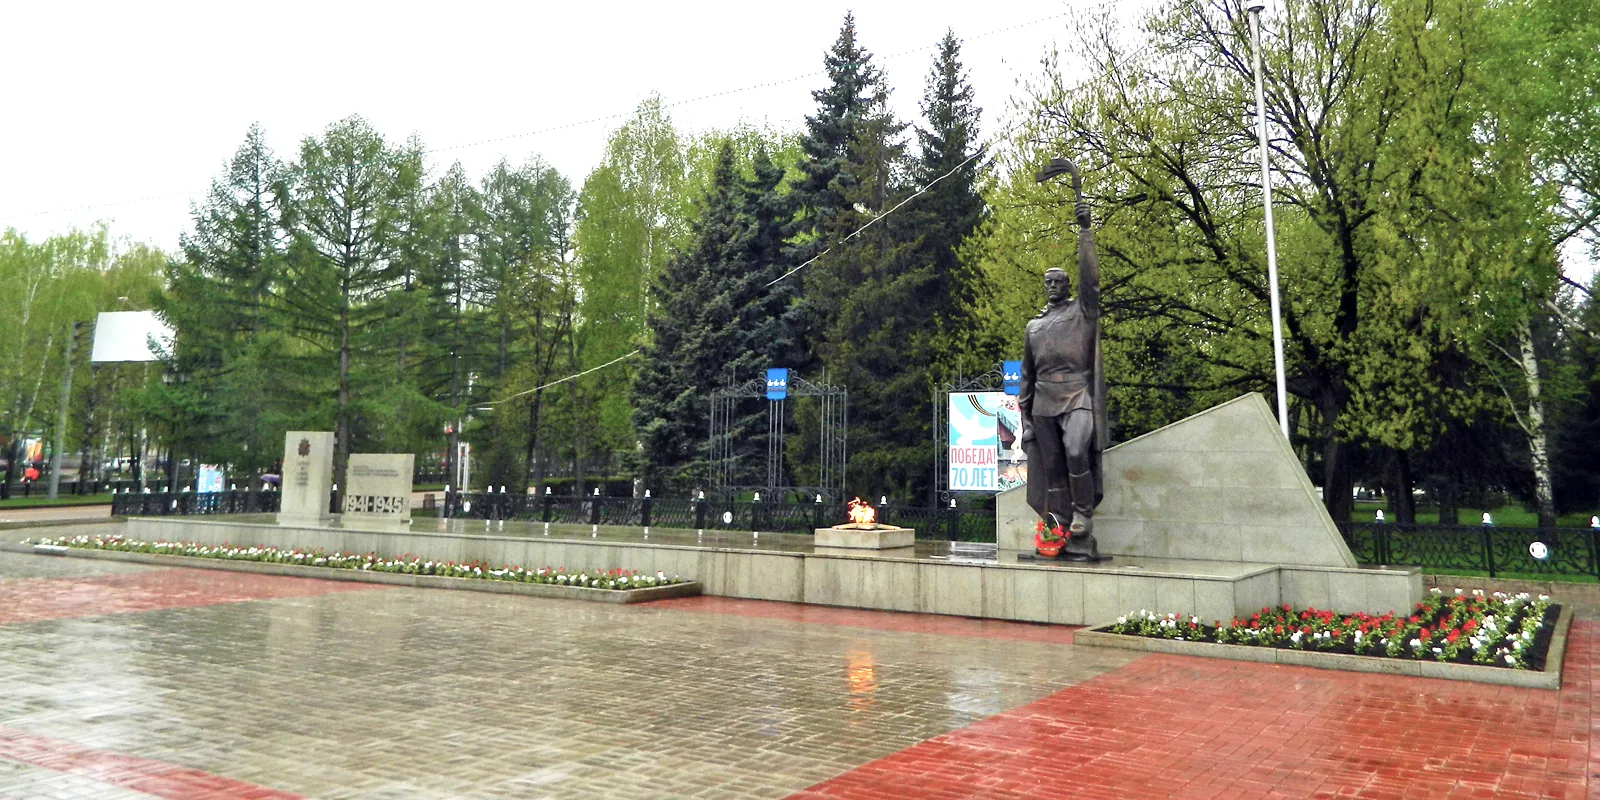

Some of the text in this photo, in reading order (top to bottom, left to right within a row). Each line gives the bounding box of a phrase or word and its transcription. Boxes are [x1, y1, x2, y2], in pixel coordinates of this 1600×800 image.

[951, 448, 996, 465] ПОБЕДА!
[952, 468, 996, 487] 70 ЛЕТ
